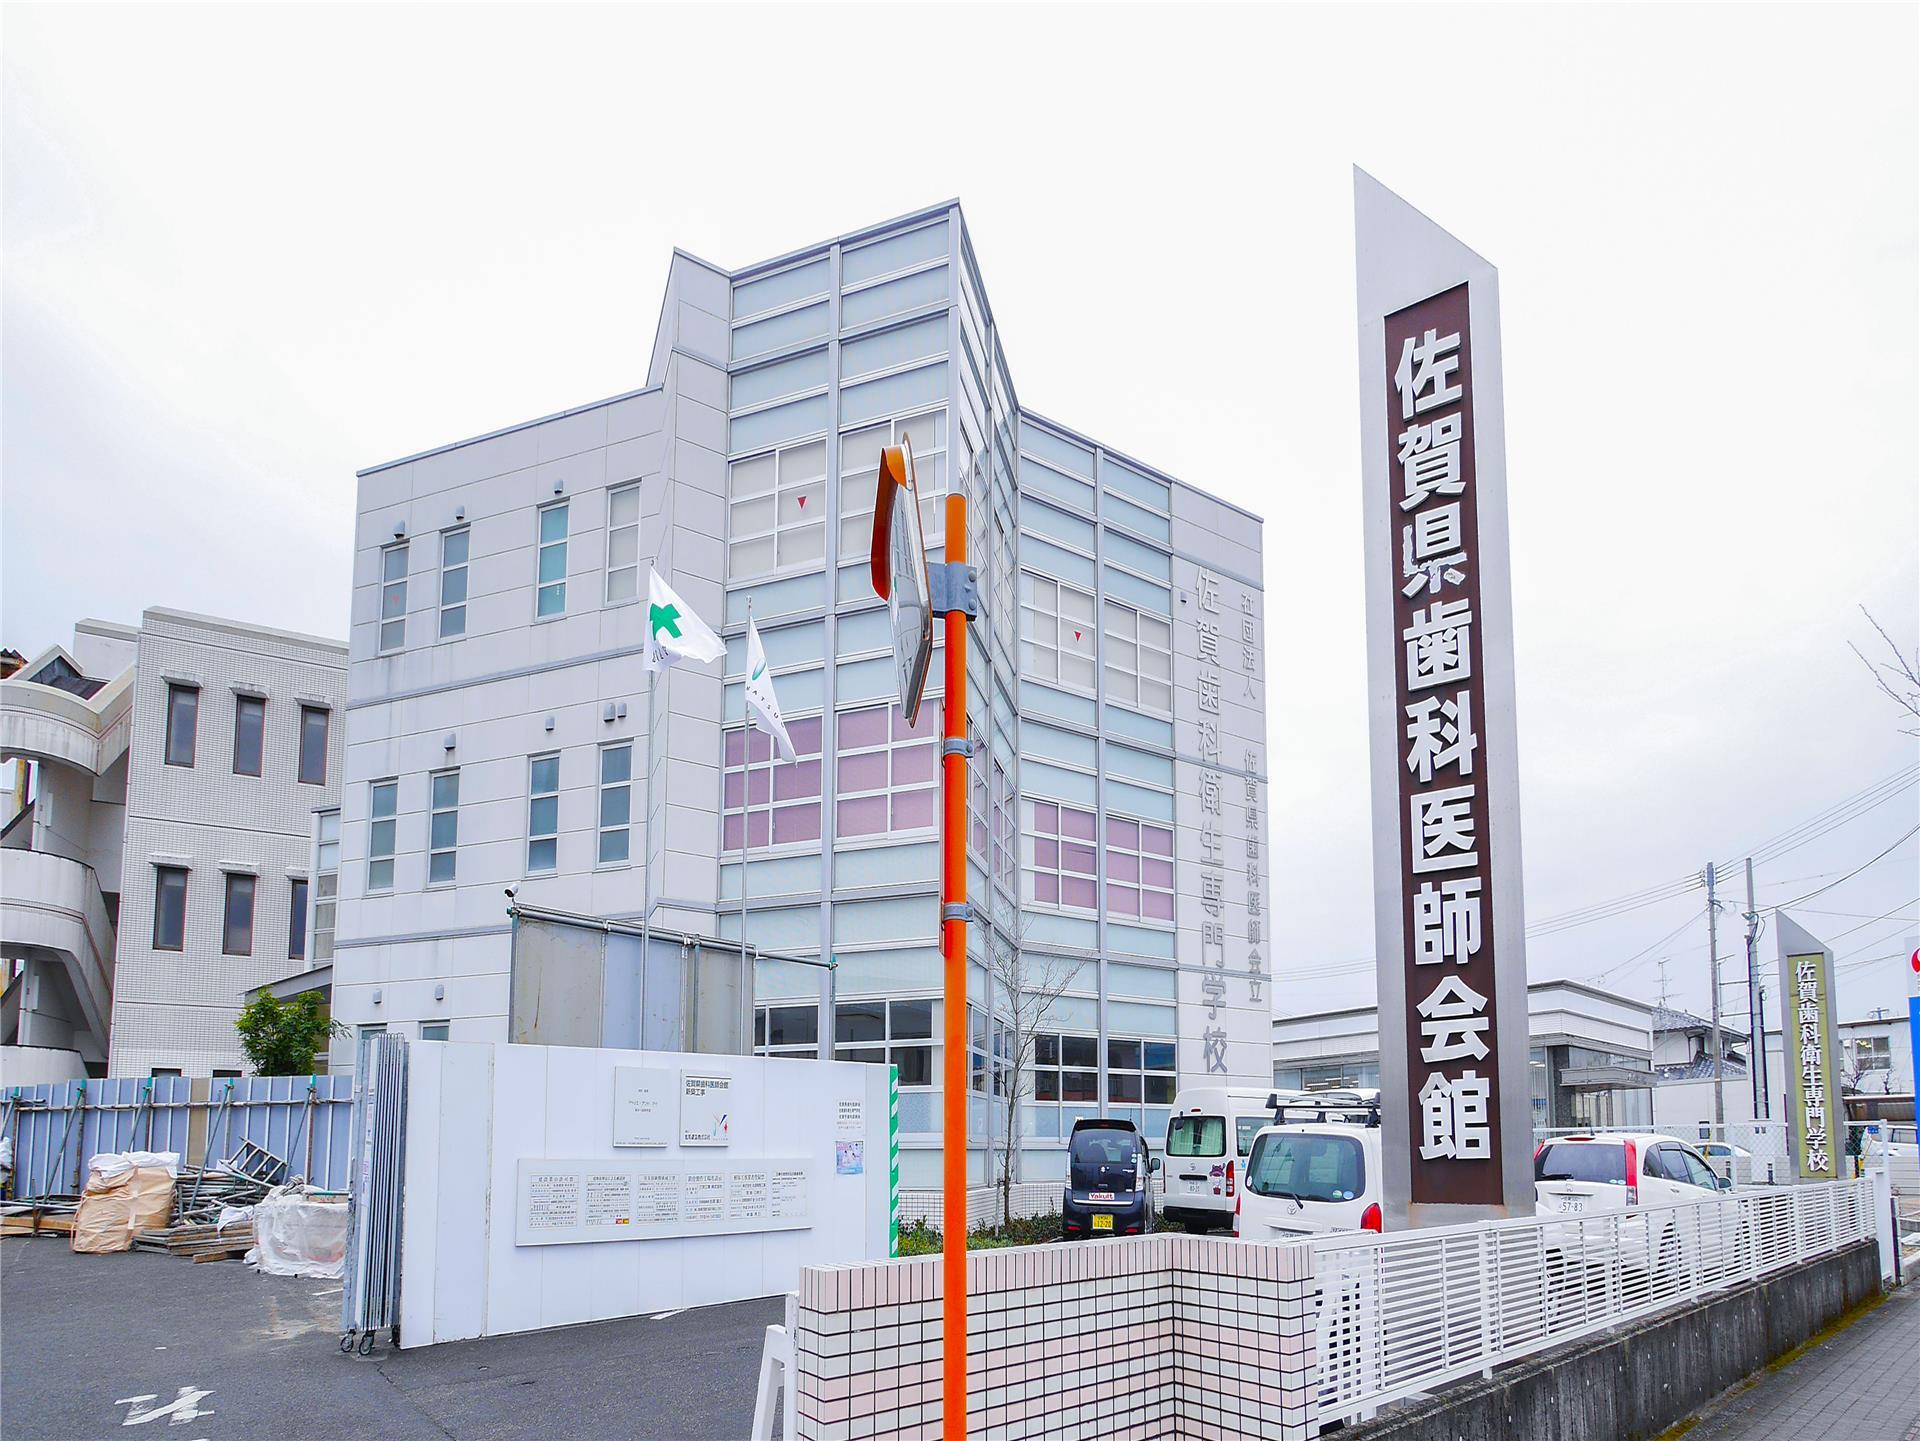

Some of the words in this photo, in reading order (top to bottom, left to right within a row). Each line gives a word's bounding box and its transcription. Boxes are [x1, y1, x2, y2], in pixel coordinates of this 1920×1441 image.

[1241, 591, 1256, 700] 社団法人
[1395, 328, 1491, 1161] 佐賀県歯科医師会館
[1195, 565, 1228, 1073] 佐賀歯科衛生専門学校
[1244, 748, 1263, 1002] 佐賀県歯科医師会立
[1795, 960, 1829, 1172] 佐賀歯科衛生専門学校
